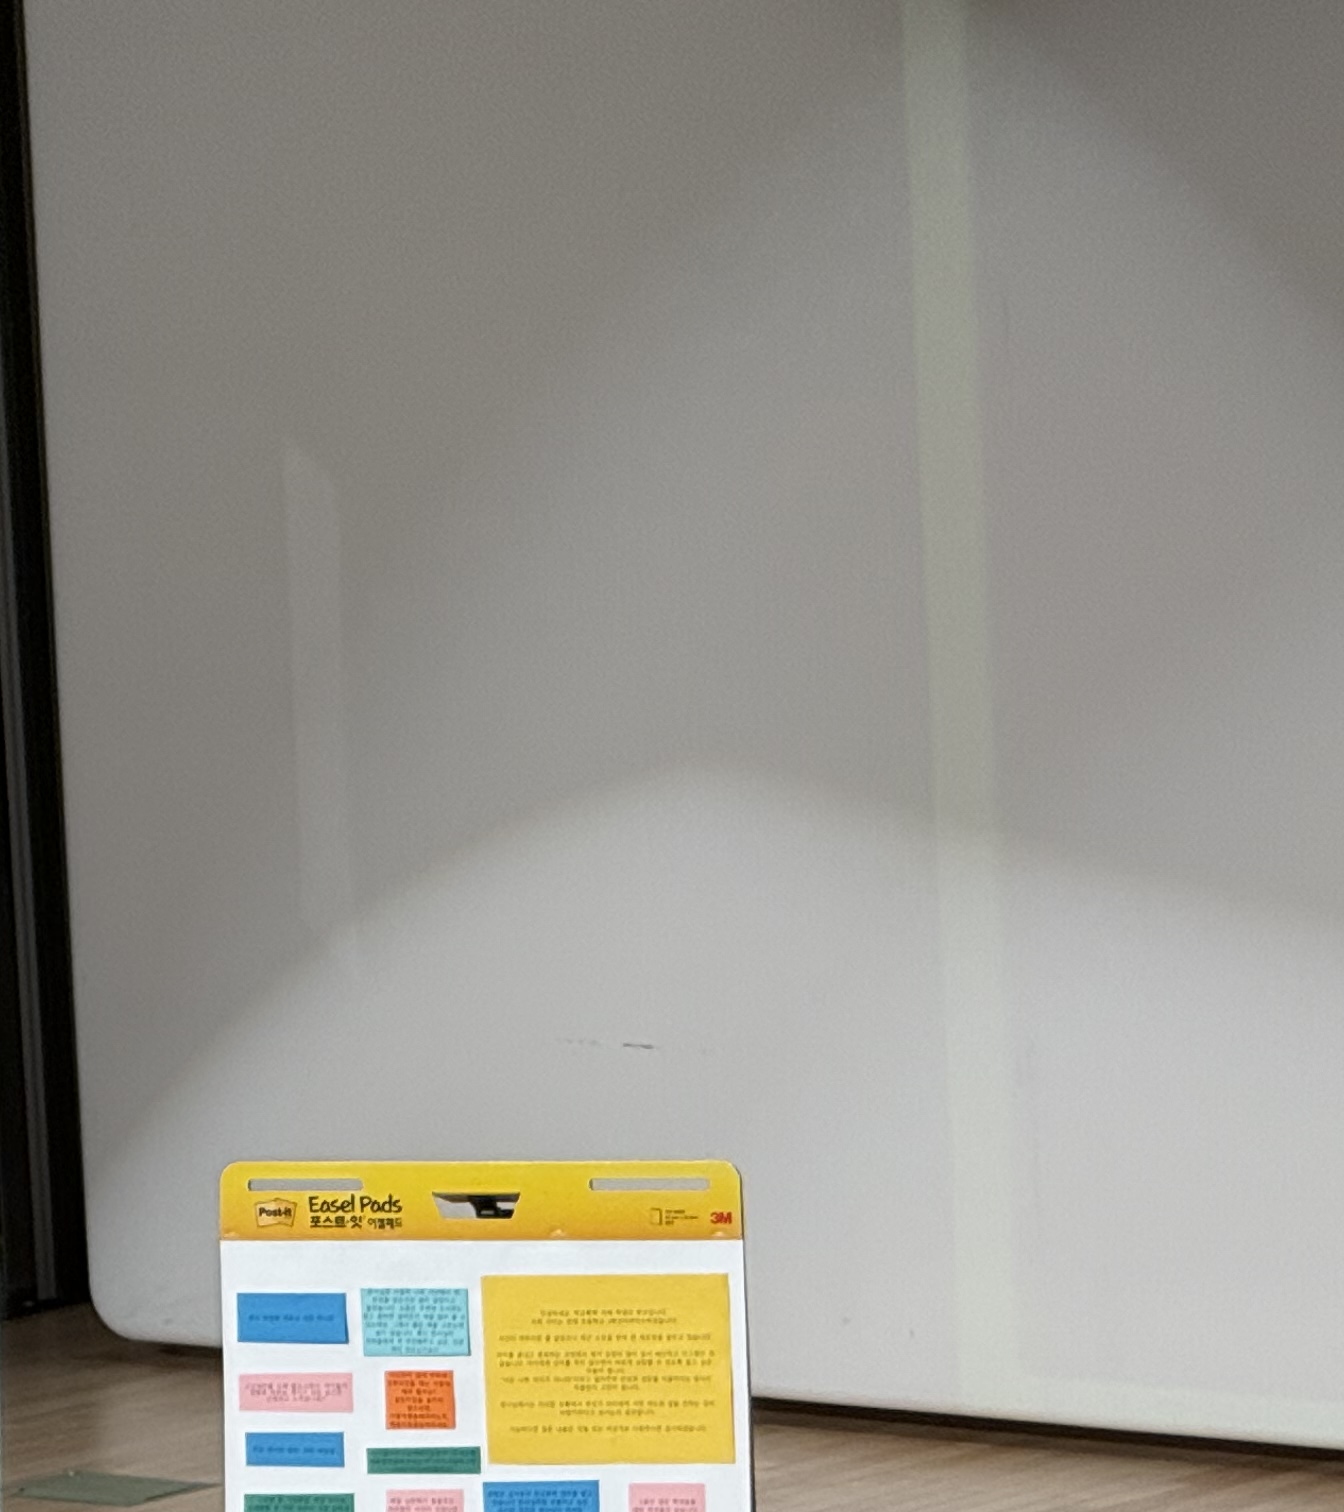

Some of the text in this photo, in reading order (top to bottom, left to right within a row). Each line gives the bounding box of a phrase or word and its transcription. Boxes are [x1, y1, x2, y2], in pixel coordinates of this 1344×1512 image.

[308, 1193, 403, 1213] Easel Pads
[258, 1206, 292, 1217] Post-it
[710, 1211, 732, 1225] 3M
